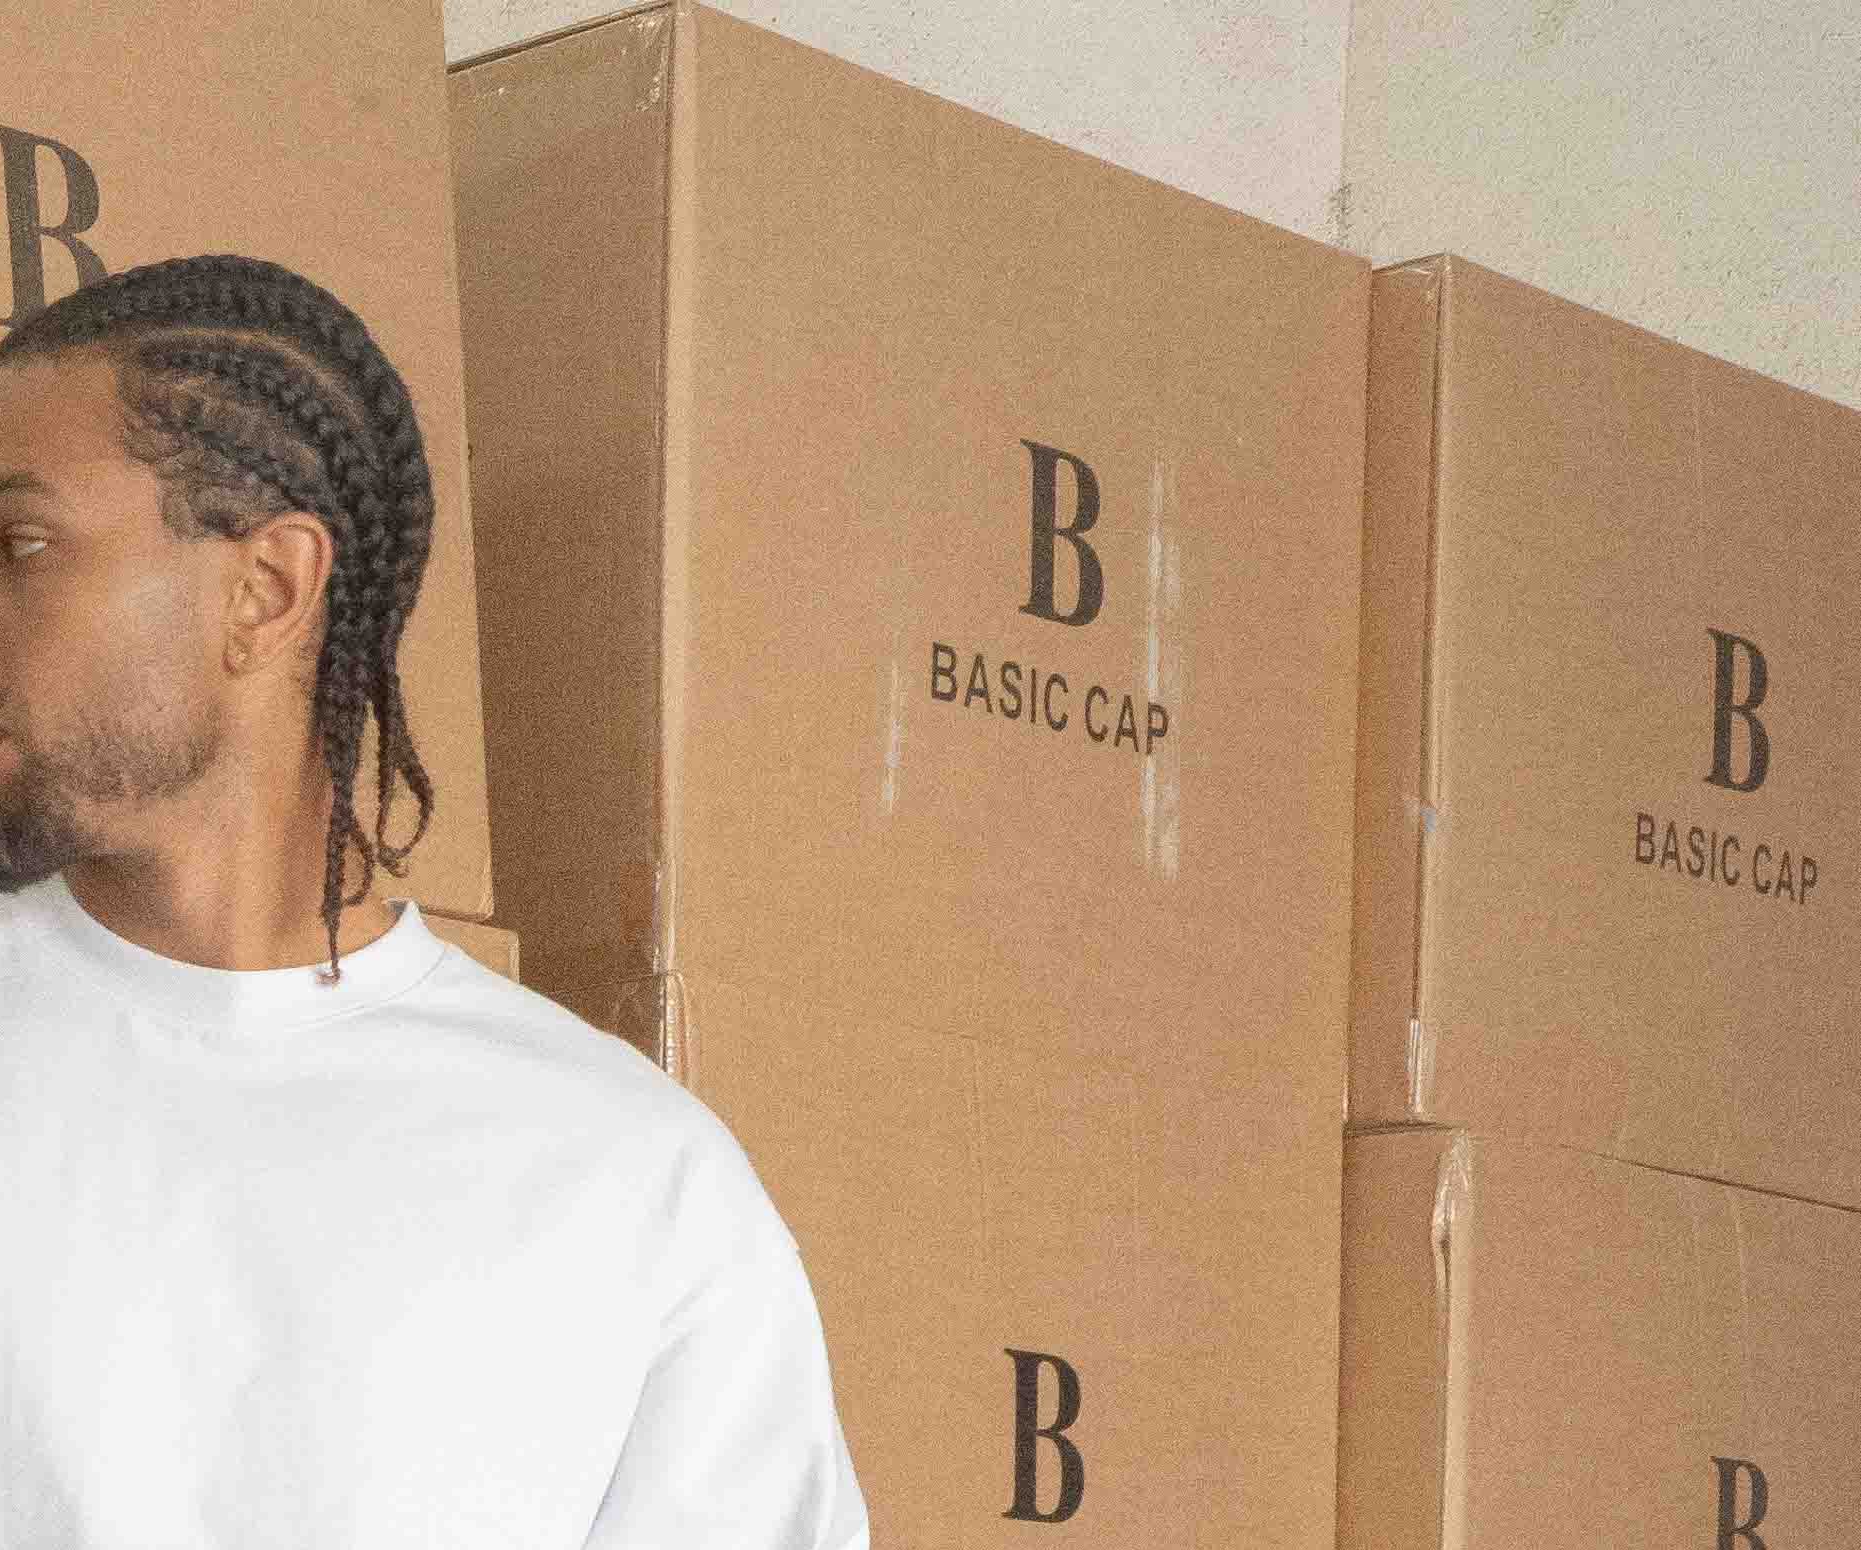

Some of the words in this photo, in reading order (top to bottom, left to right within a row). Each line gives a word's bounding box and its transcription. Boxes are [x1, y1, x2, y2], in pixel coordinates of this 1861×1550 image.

[1019, 438, 1104, 627] B
[930, 641, 1070, 732] BASIC
[1084, 686, 1170, 756] CAP
[1704, 627, 1771, 793] B
[1634, 811, 1741, 887] BASIC
[1752, 844, 1819, 905] CAP
[1001, 1348, 1085, 1523] B
